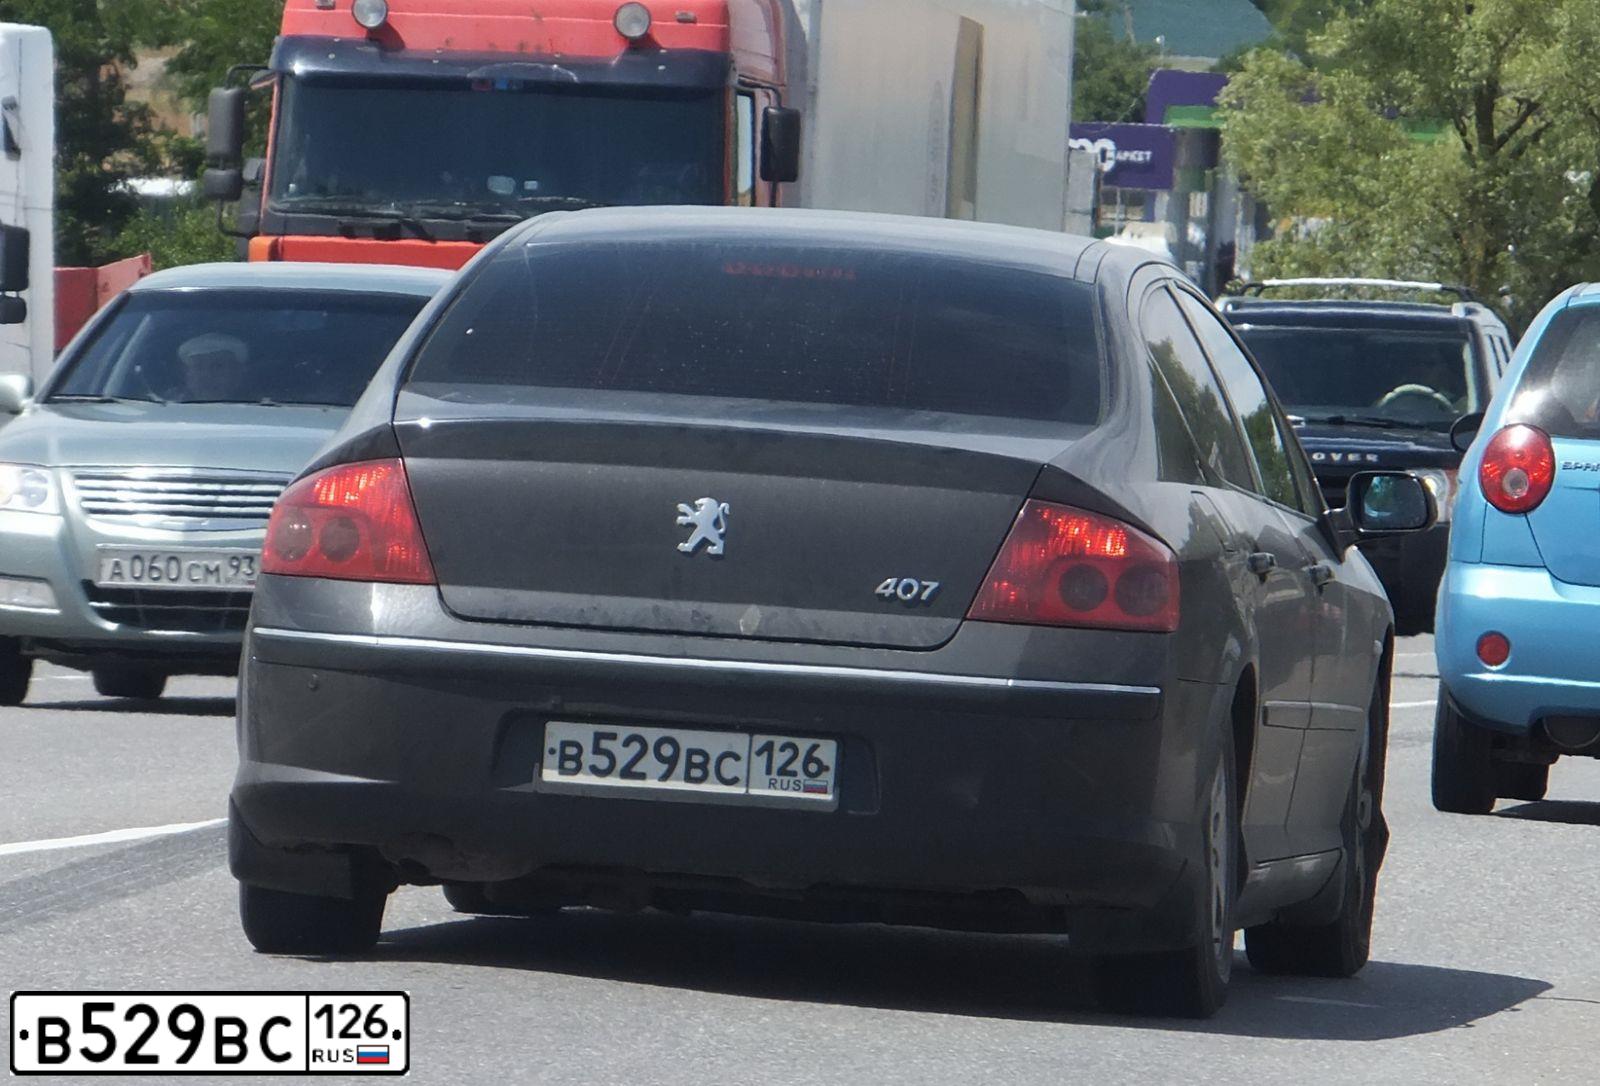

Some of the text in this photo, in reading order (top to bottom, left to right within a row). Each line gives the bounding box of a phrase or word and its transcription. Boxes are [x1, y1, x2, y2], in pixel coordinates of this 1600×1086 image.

[1312, 452, 1378, 462] OVER
[875, 577, 939, 600] 407
[755, 740, 824, 778] 126
[768, 778, 801, 792] RUS
